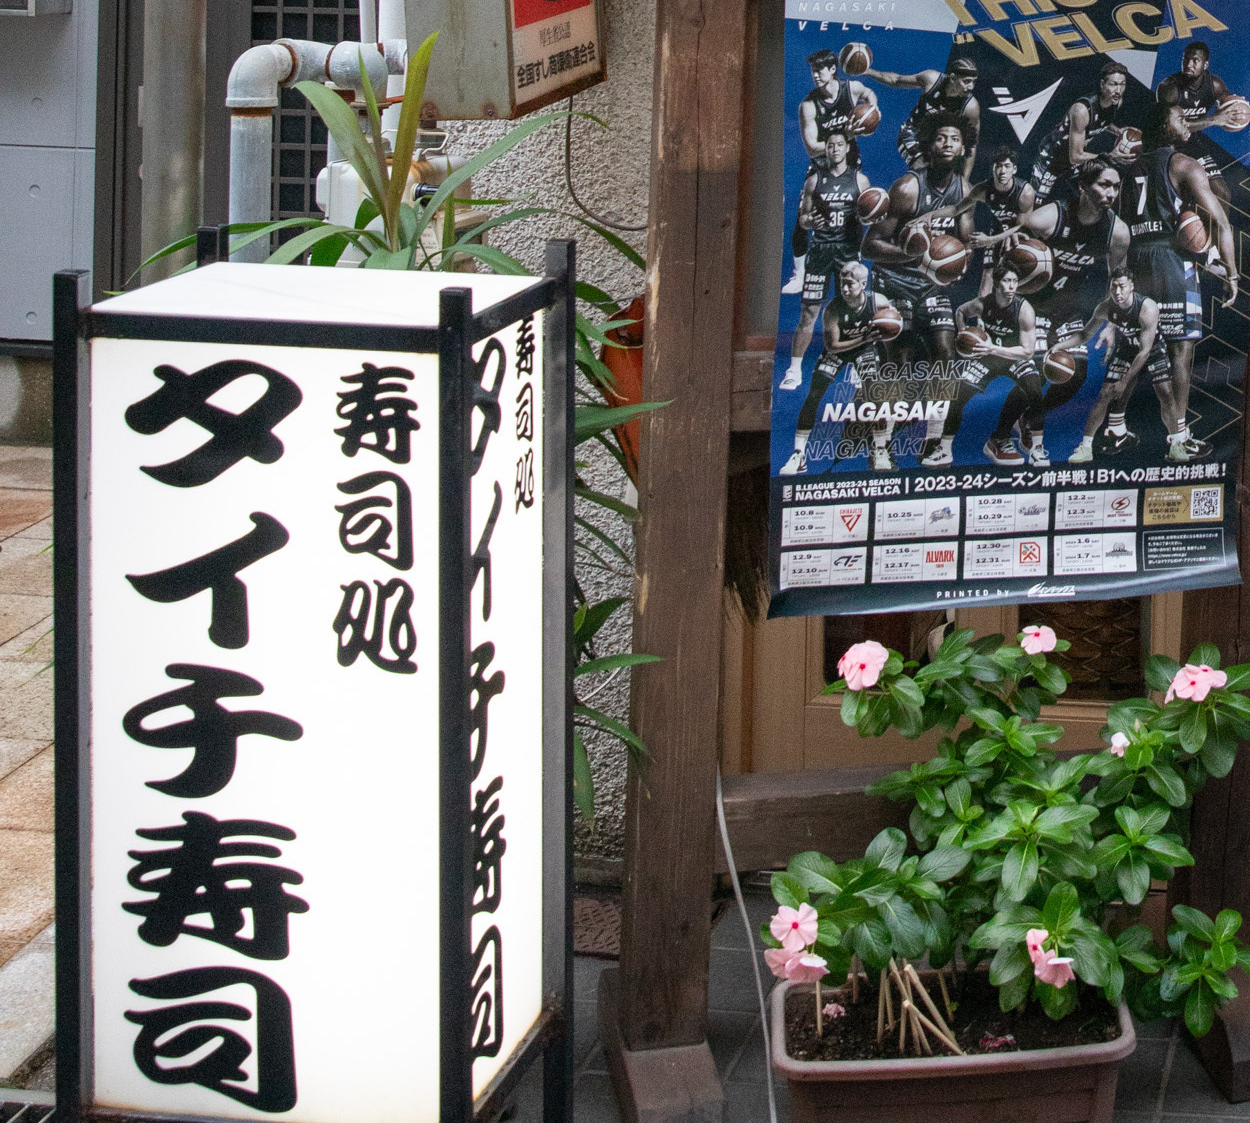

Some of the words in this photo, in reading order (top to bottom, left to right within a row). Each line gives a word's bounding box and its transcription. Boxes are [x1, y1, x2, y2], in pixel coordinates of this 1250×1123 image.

[799, 2, 896, 12] NAGASAKI
[798, 21, 894, 31] VELCA
[820, 192, 853, 201] VELCA
[1135, 176, 1148, 215] 7
[829, 211, 844, 226] 36
[1053, 276, 1068, 291] 4
[822, 400, 950, 422] NAGASAKI
[796, 482, 835, 491] B.LEAGUE
[837, 480, 867, 489] 2023-24
[869, 478, 901, 488] SEASON
[795, 488, 859, 501] NAGASAKI
[863, 485, 900, 497] VELCA
[334, 362, 421, 675] 寿司処
[926, 550, 954, 563] ALVARK
[936, 589, 989, 598] PRINTED
[997, 589, 1009, 597] by
[122, 358, 310, 1114] タイチ寿司
